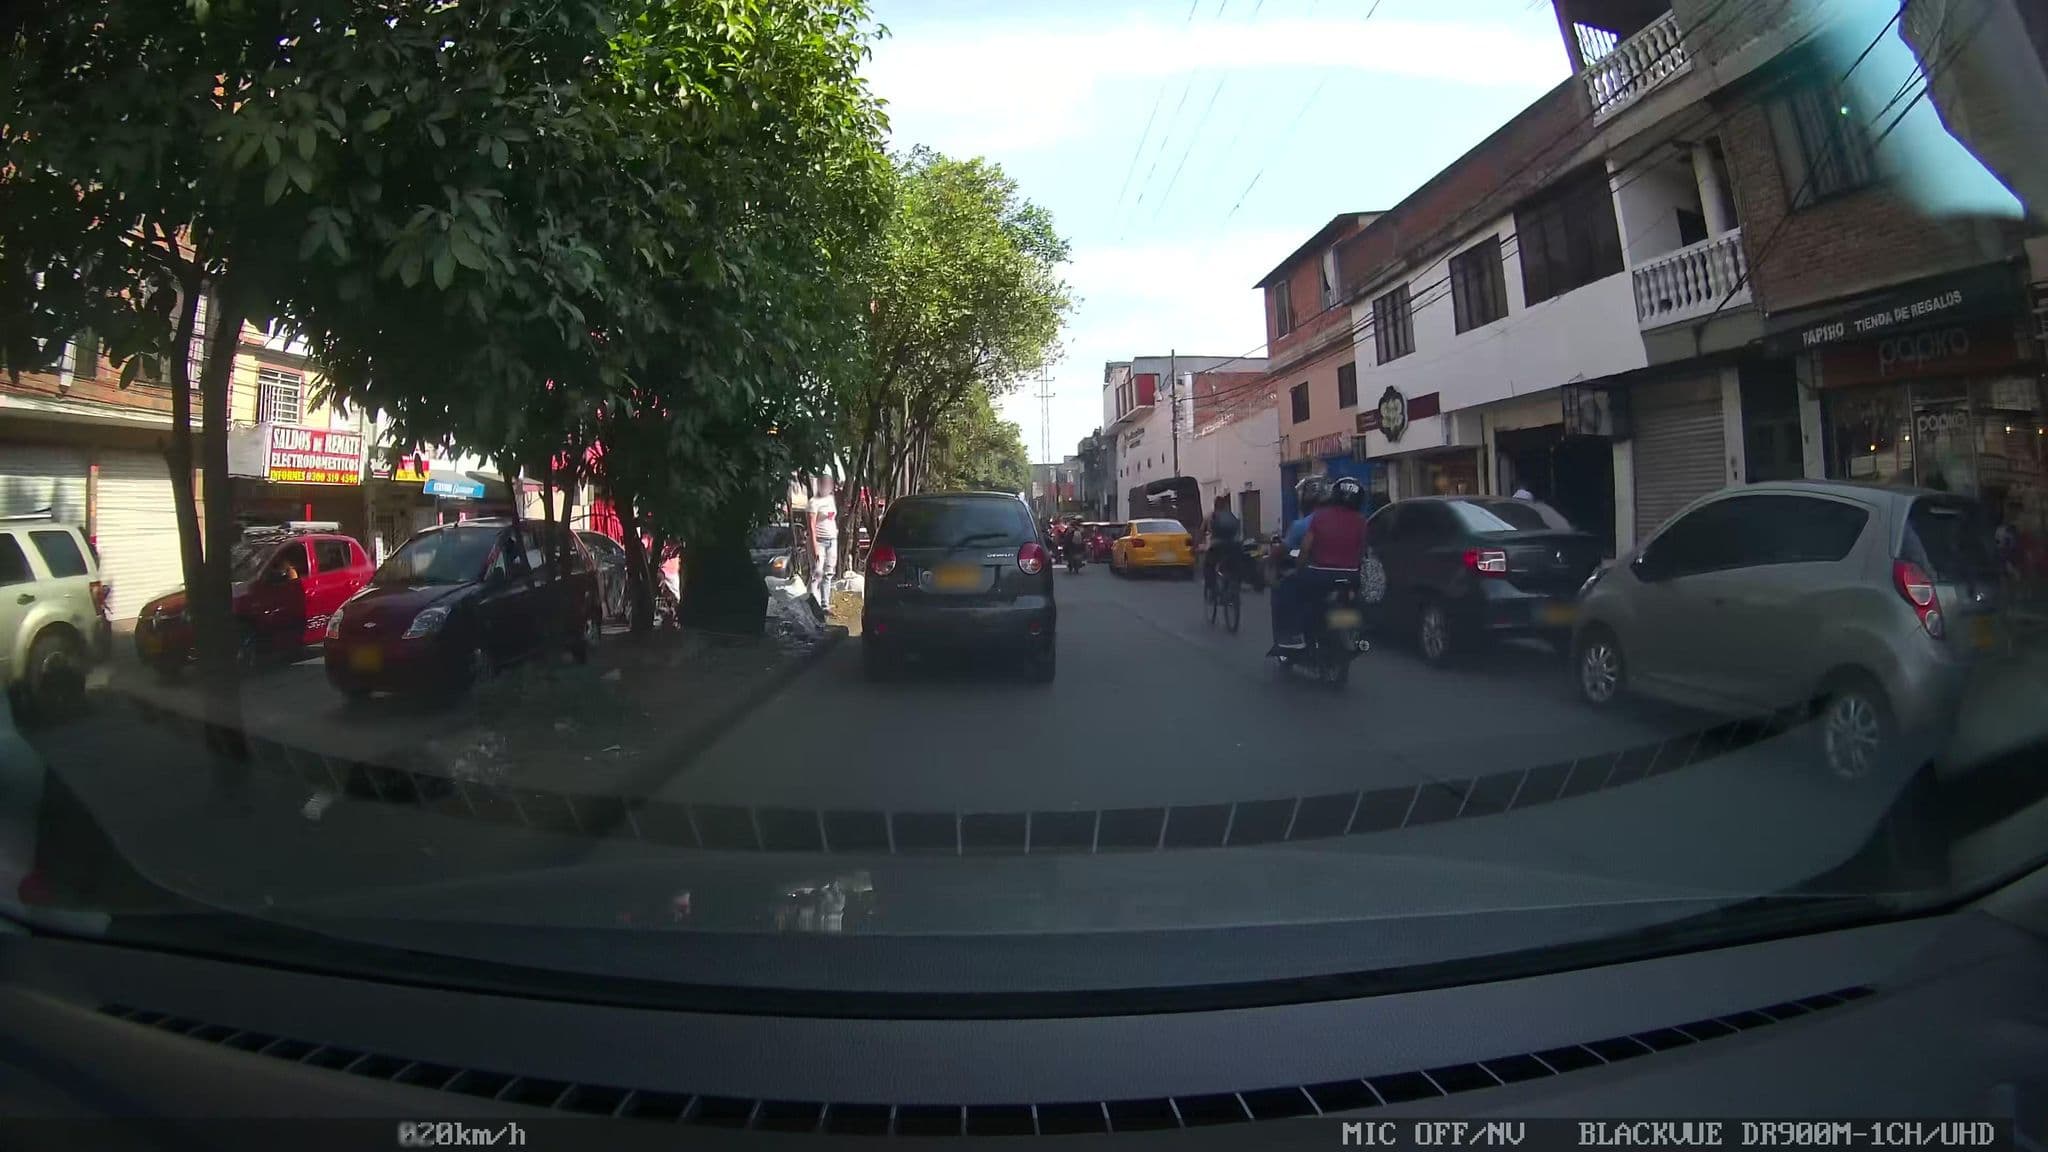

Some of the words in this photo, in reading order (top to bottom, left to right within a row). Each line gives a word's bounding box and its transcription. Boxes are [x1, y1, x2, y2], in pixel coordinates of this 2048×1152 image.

[1854, 311, 1893, 331] TIENDA
[1894, 306, 1910, 321] DE
[1911, 290, 1962, 317] REGALOS
[273, 428, 311, 451] SALDOS
[324, 432, 359, 455] REMATE
[271, 452, 359, 471] ELECTRODOMESTICOS
[271, 469, 305, 481] INFORMES
